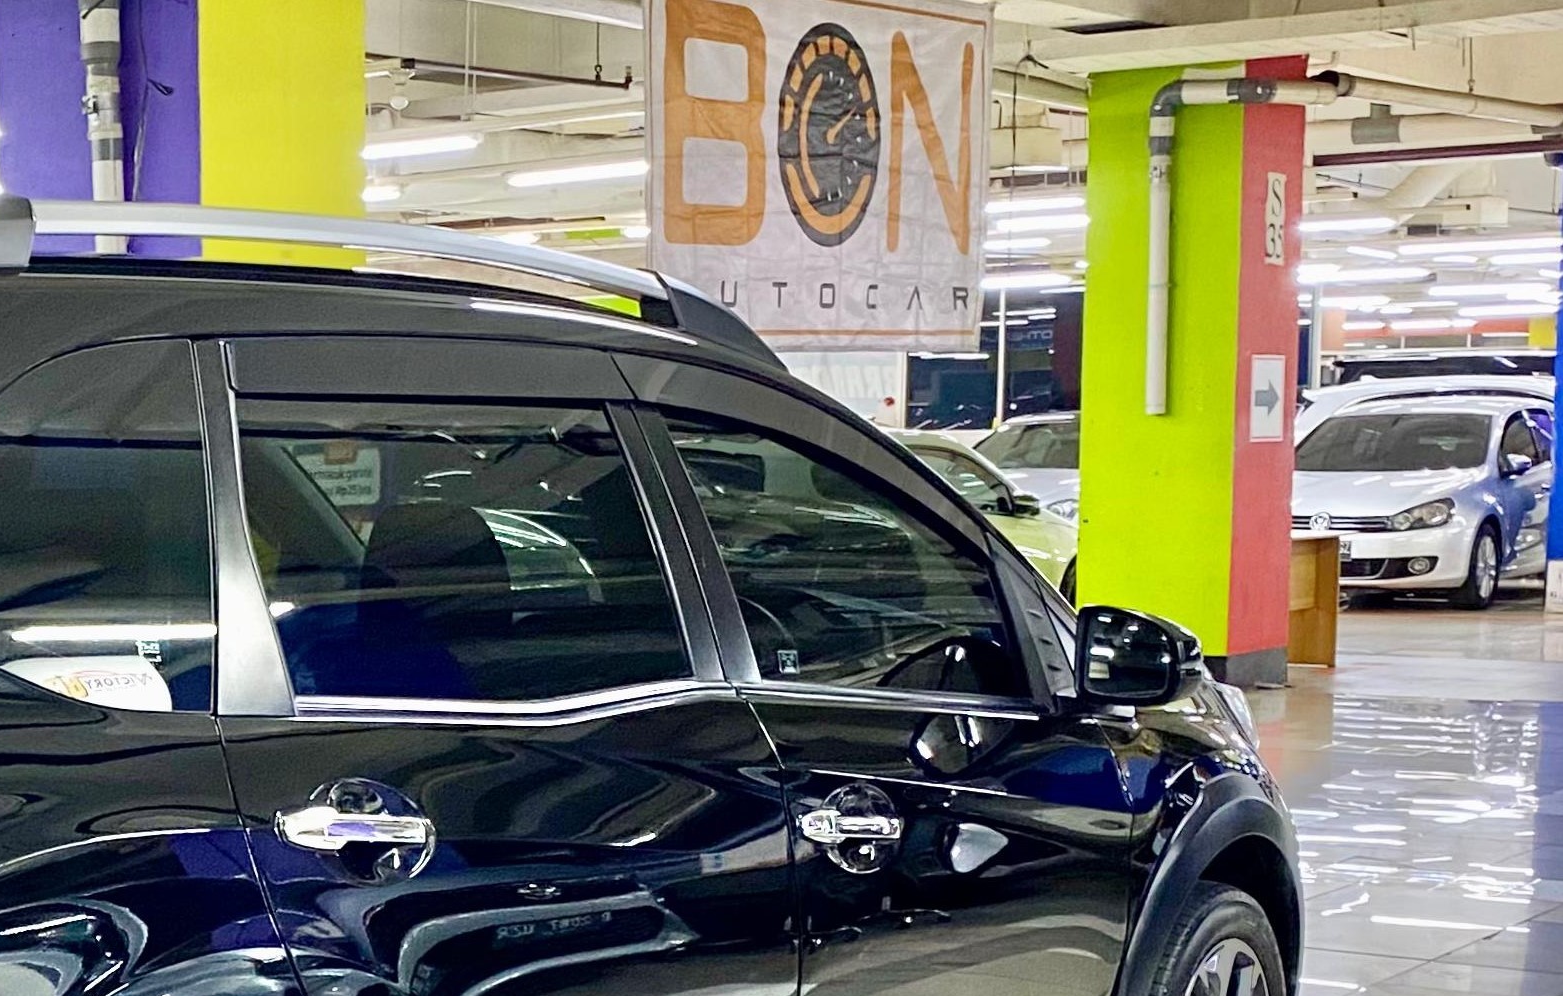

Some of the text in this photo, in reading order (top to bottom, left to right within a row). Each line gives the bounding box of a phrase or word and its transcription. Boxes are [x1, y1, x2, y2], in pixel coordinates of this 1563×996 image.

[1271, 177, 1282, 217] S
[1264, 222, 1284, 259] 35
[720, 280, 969, 311] UTOCAR
